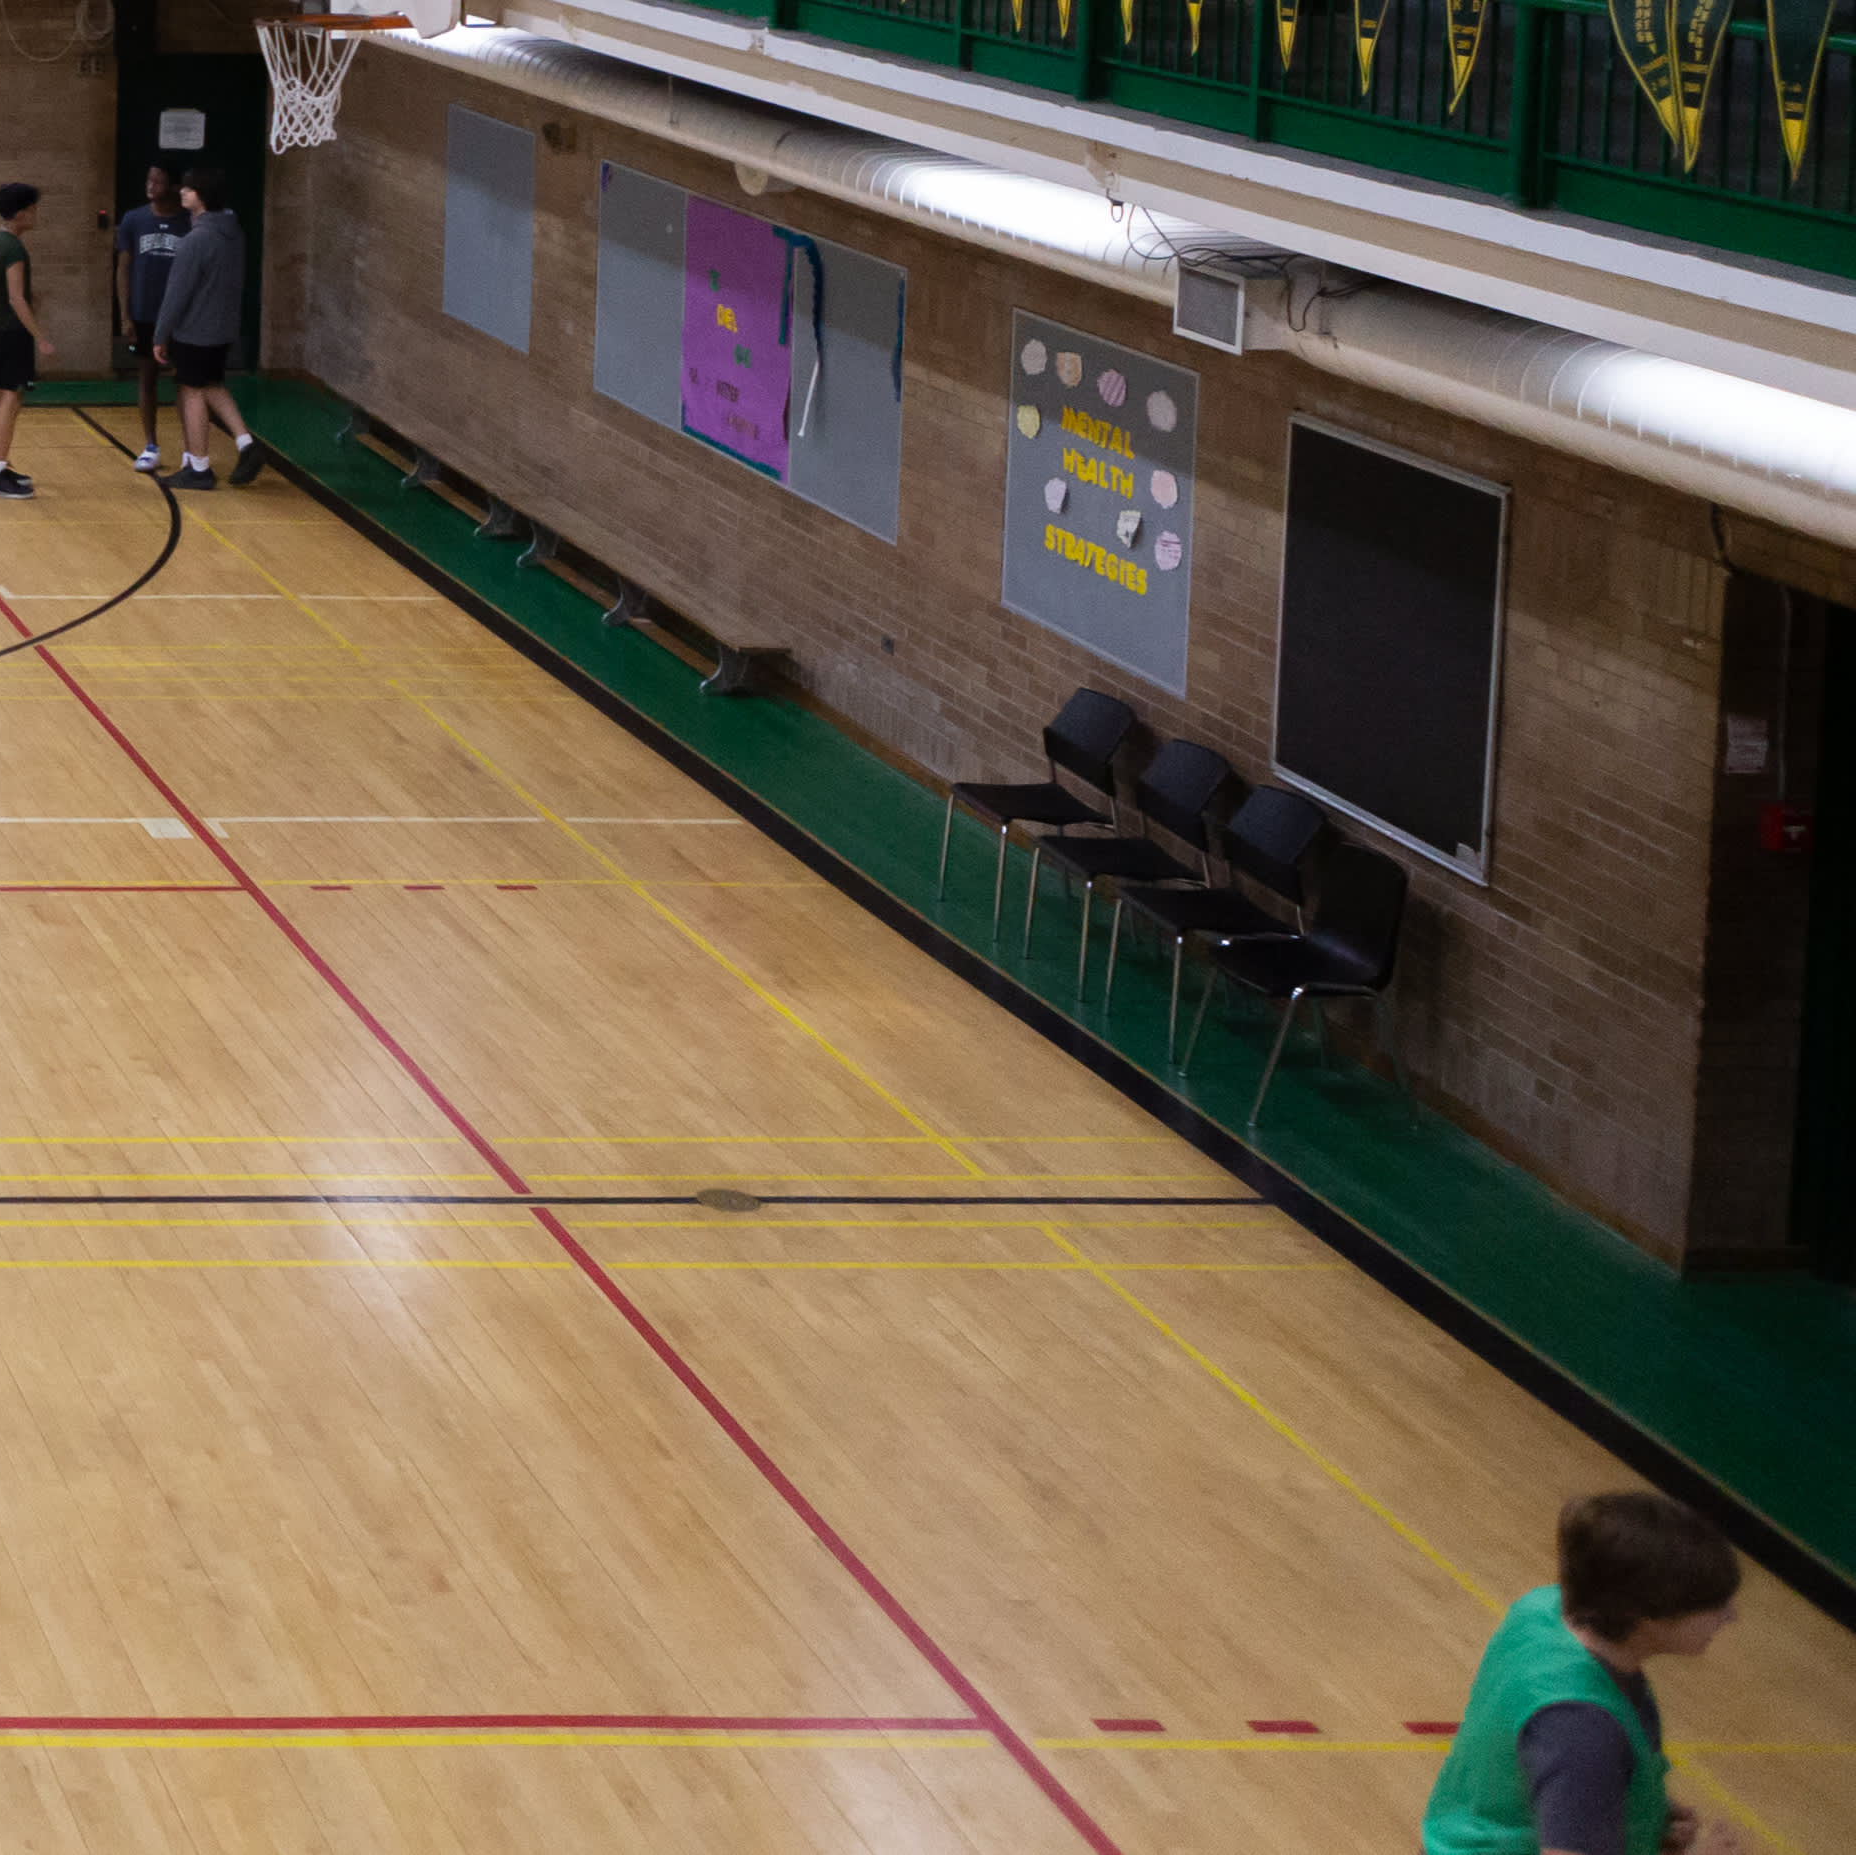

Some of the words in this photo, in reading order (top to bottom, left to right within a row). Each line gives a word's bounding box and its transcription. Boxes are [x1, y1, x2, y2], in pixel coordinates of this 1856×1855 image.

[1060, 406, 1135, 459] MENTAL
[1063, 448, 1133, 499] HEALTH
[1044, 524, 1148, 595] STRATEGIES
